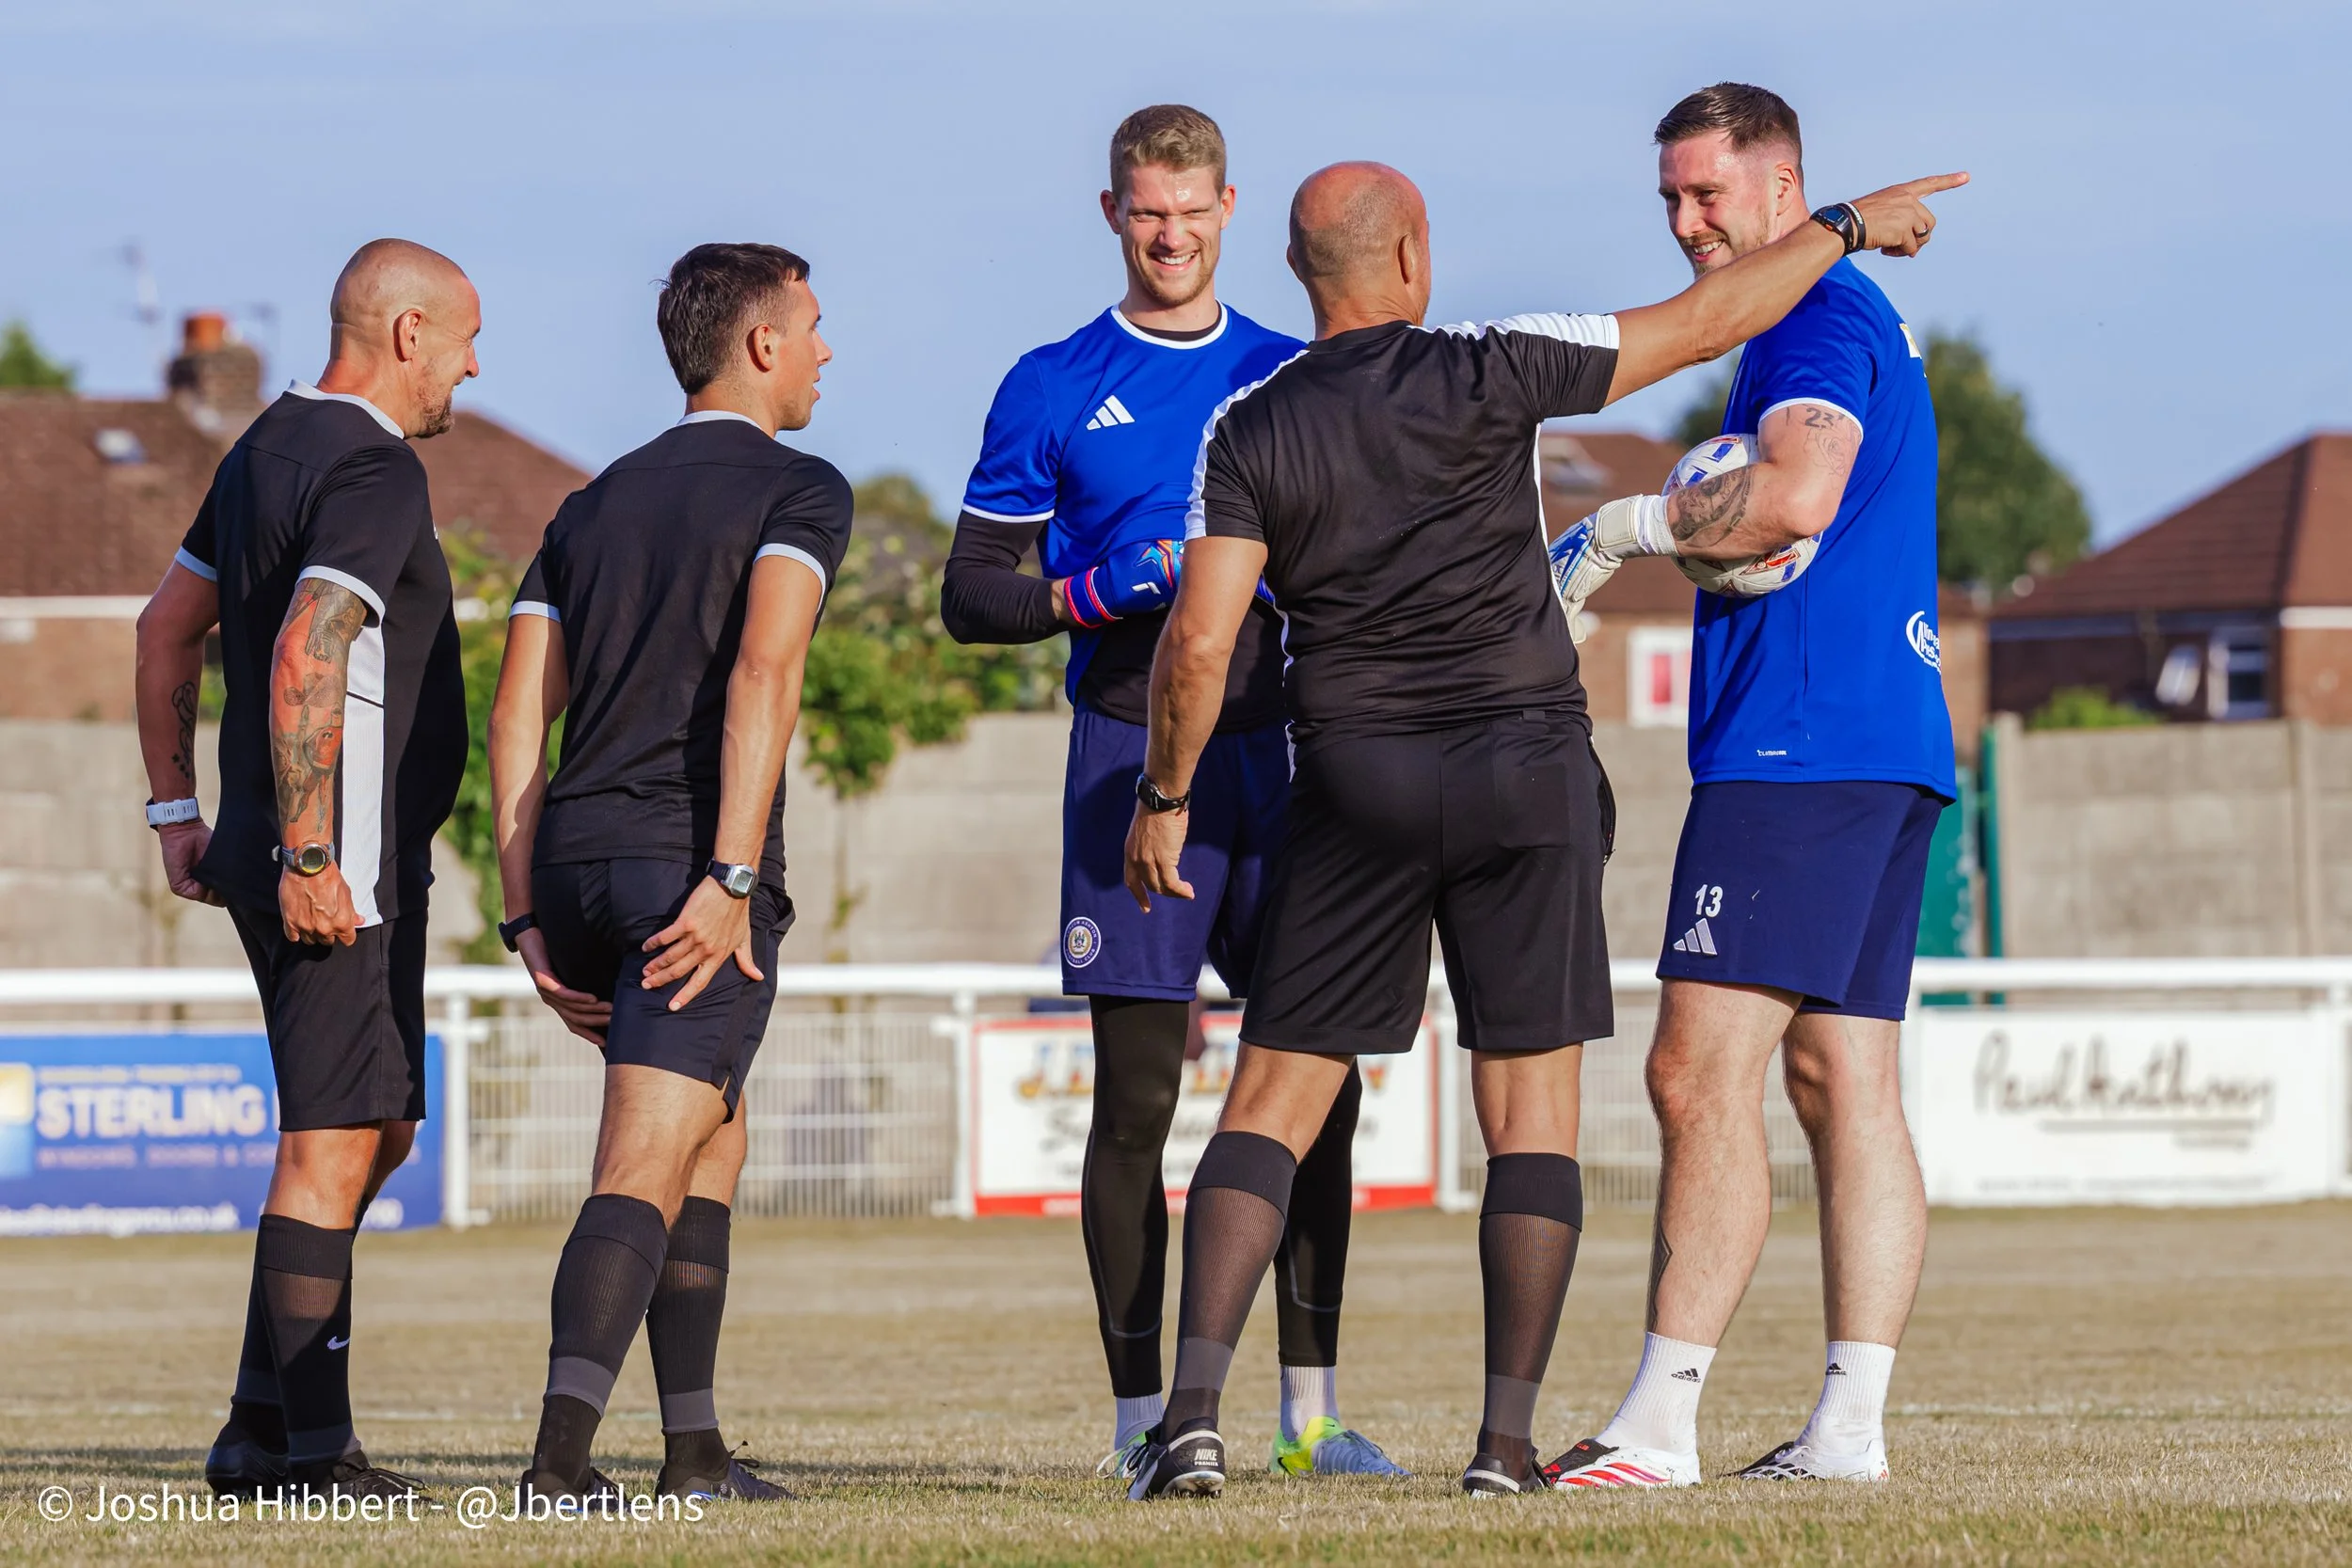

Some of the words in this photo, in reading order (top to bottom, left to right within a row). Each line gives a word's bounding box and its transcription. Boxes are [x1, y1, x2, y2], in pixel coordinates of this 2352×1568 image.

[1695, 884, 1723, 918] 13
[38, 1085, 266, 1139] STERLING
[1671, 1373, 1701, 1383] adidas
[1195, 1449, 1217, 1461] NIKE
